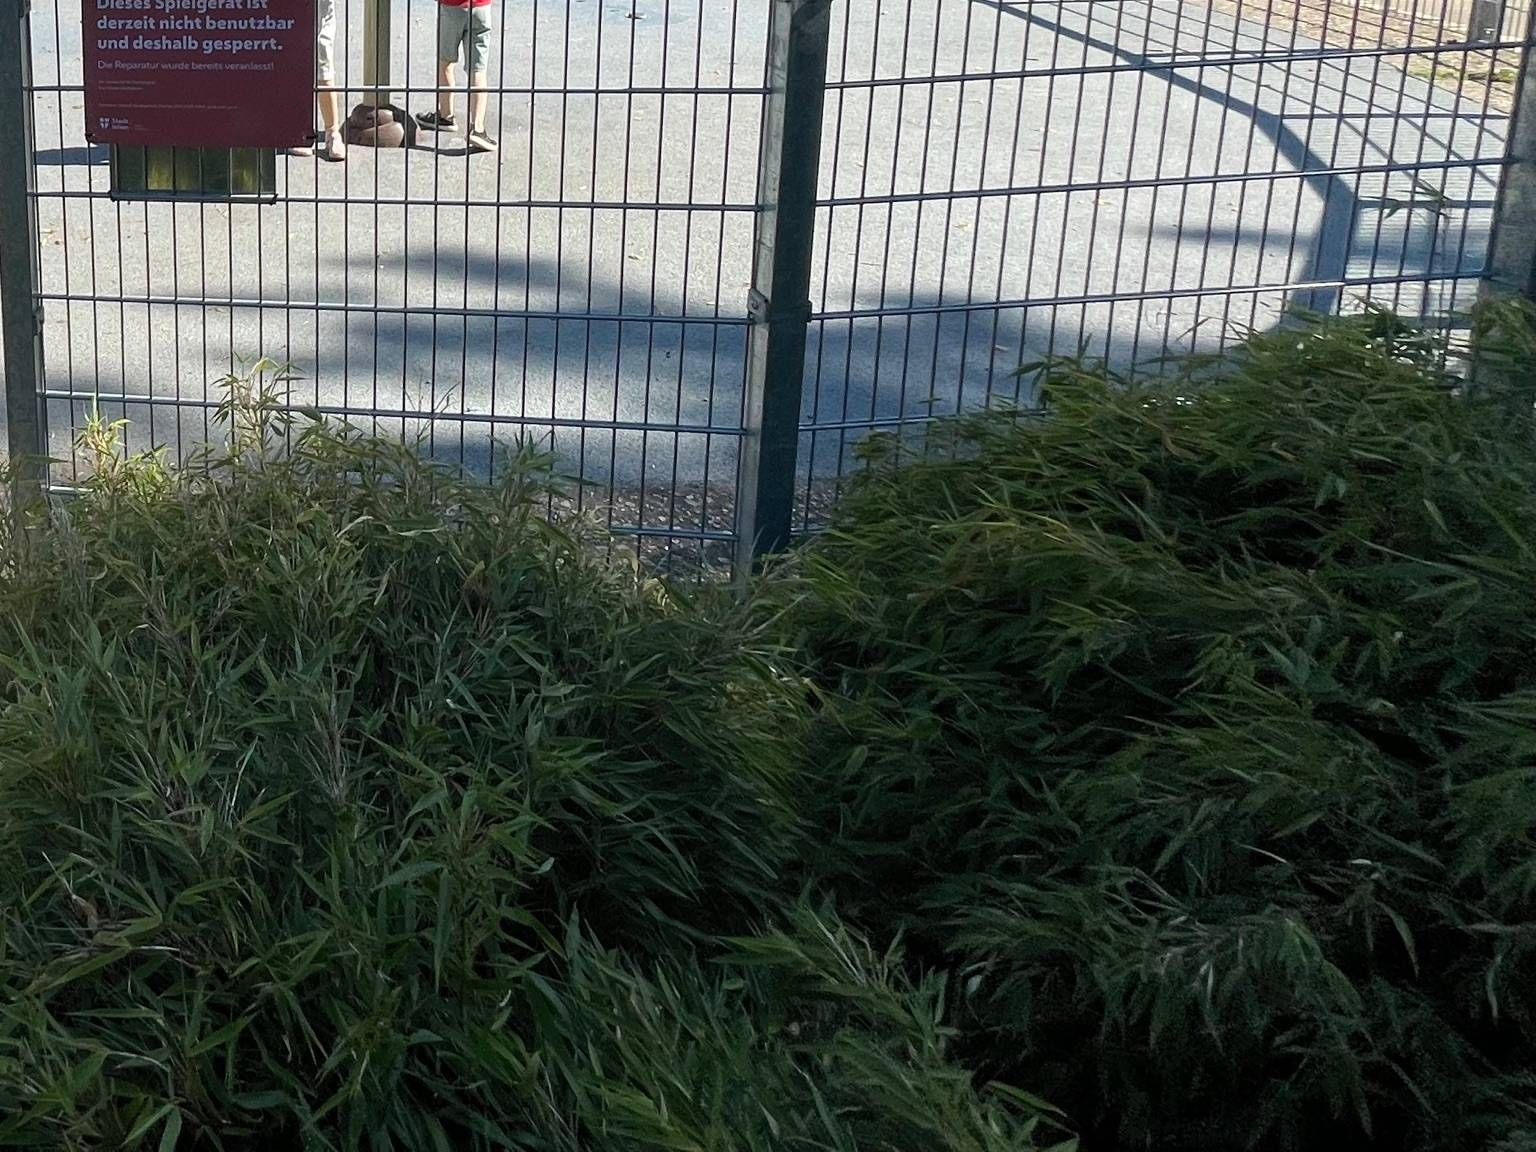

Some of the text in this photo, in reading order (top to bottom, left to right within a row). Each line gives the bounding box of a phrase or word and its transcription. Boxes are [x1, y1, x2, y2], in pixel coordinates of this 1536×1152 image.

[97, 16, 295, 30] derzeit nicht benutzbar
[97, 36, 283, 54] und deshalb gesperrt.
[115, 60, 159, 72] Reparatur
[161, 61, 189, 70] wurde
[191, 61, 223, 70] bereits
